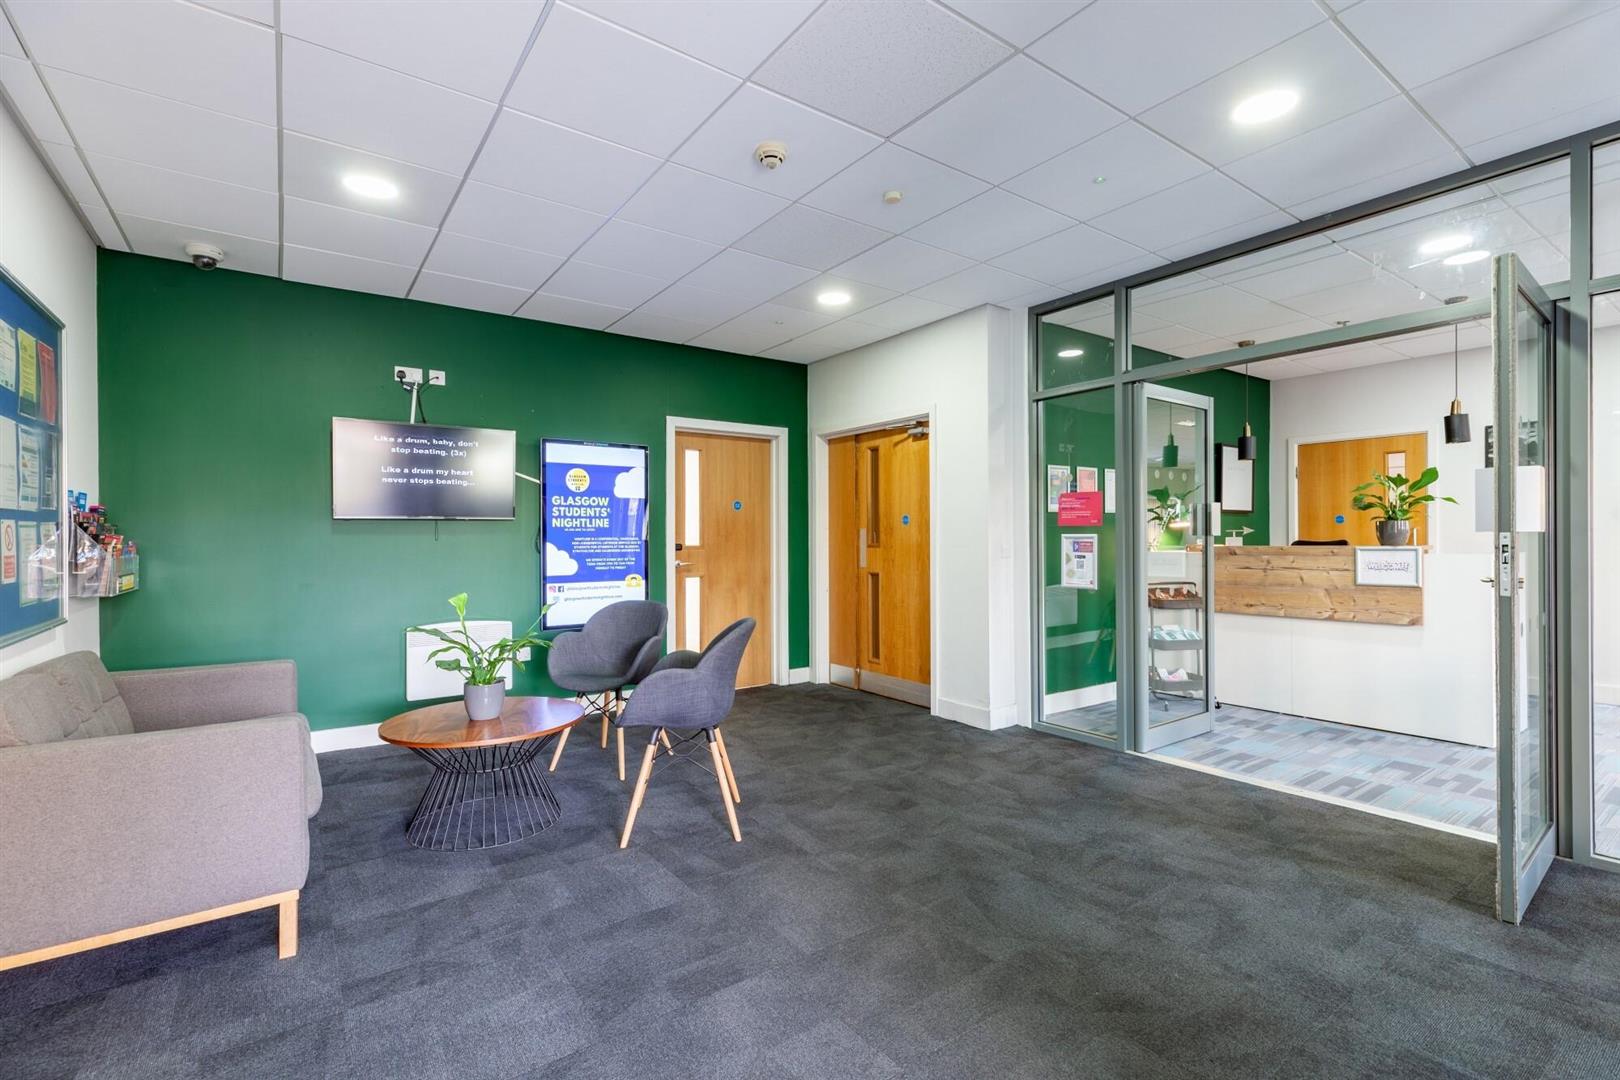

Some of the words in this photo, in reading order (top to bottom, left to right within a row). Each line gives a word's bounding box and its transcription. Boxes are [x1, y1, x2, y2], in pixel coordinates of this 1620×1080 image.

[374, 434, 395, 442] Like
[405, 437, 430, 445] drum,
[433, 439, 456, 447] baby,
[458, 440, 479, 448] don't
[413, 447, 448, 456] beating.
[451, 449, 467, 458] (3x)
[381, 465, 401, 473] Like
[411, 467, 433, 475] drum
[451, 468, 474, 476] heart
[410, 477, 434, 485] stops
[552, 495, 609, 506] GLASGOW
[552, 506, 610, 517] STUDENTS'
[552, 517, 610, 528] NIGHTLINE
